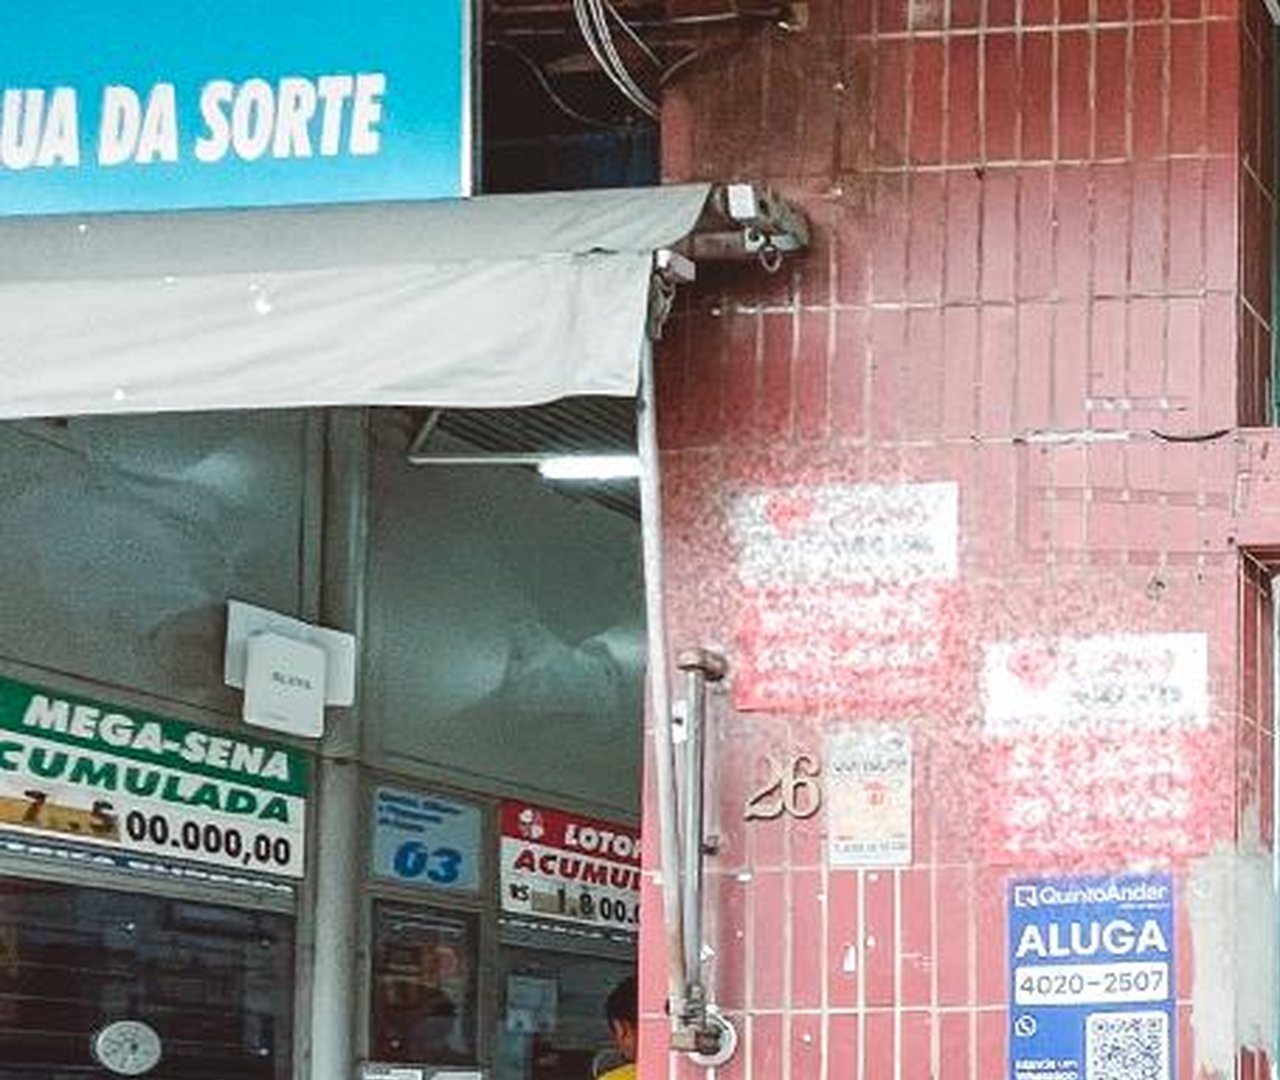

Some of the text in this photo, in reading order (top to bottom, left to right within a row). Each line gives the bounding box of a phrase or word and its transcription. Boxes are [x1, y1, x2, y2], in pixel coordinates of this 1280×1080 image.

[98, 82, 178, 166] DA
[195, 73, 386, 162] SORTE
[23, 694, 289, 781] MEGA-SENA
[744, 753, 823, 821] 26
[394, 841, 462, 884] 03
[1015, 919, 1169, 958] ALUGA
[1019, 970, 1164, 996] 4020-2507
